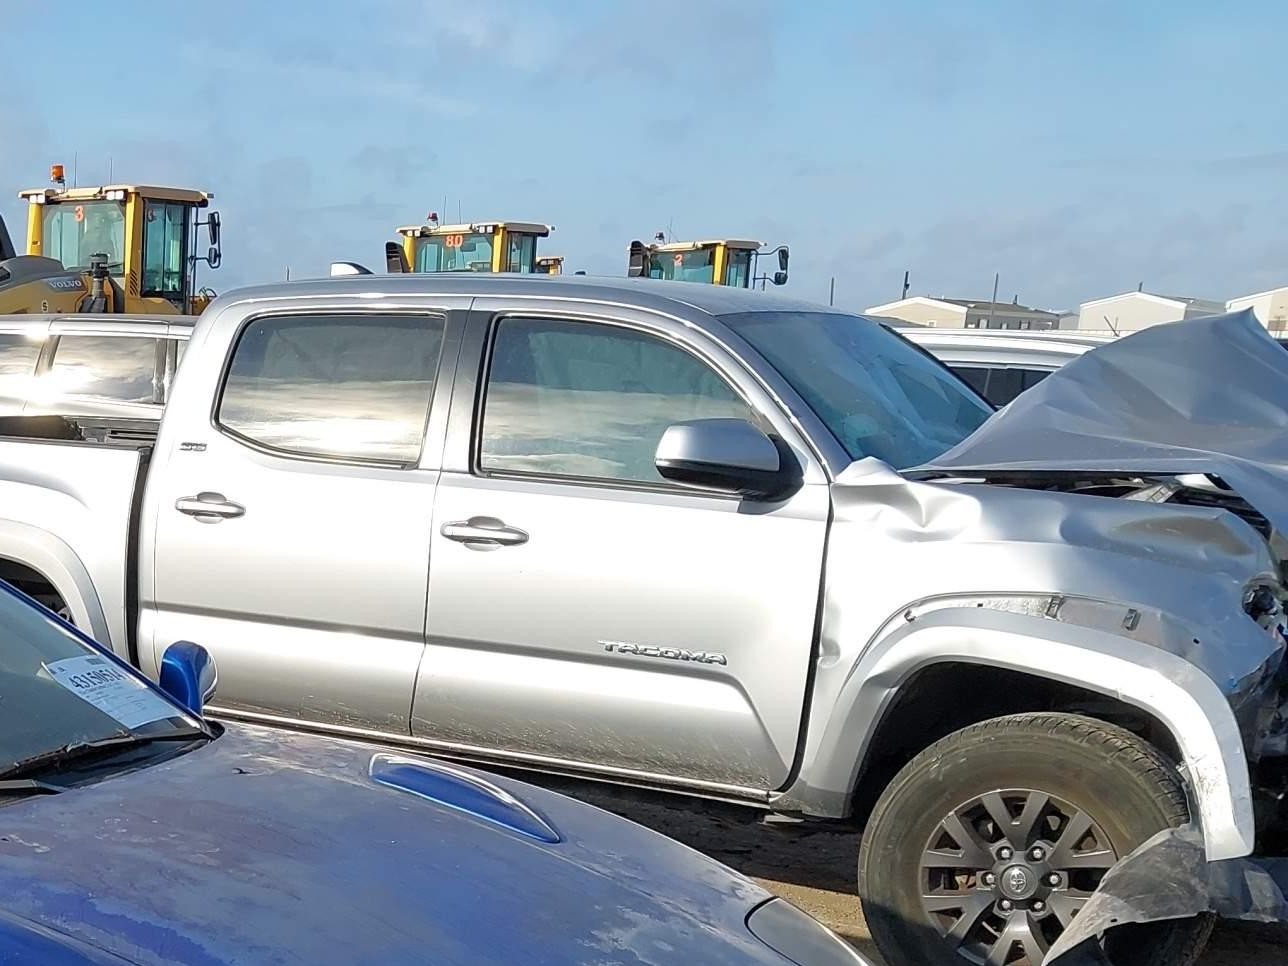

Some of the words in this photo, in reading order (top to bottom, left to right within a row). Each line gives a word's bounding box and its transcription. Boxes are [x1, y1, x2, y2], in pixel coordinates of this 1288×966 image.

[446, 235, 463, 247] 80
[48, 279, 83, 289] VOLVO
[598, 640, 728, 665] TACOMA
